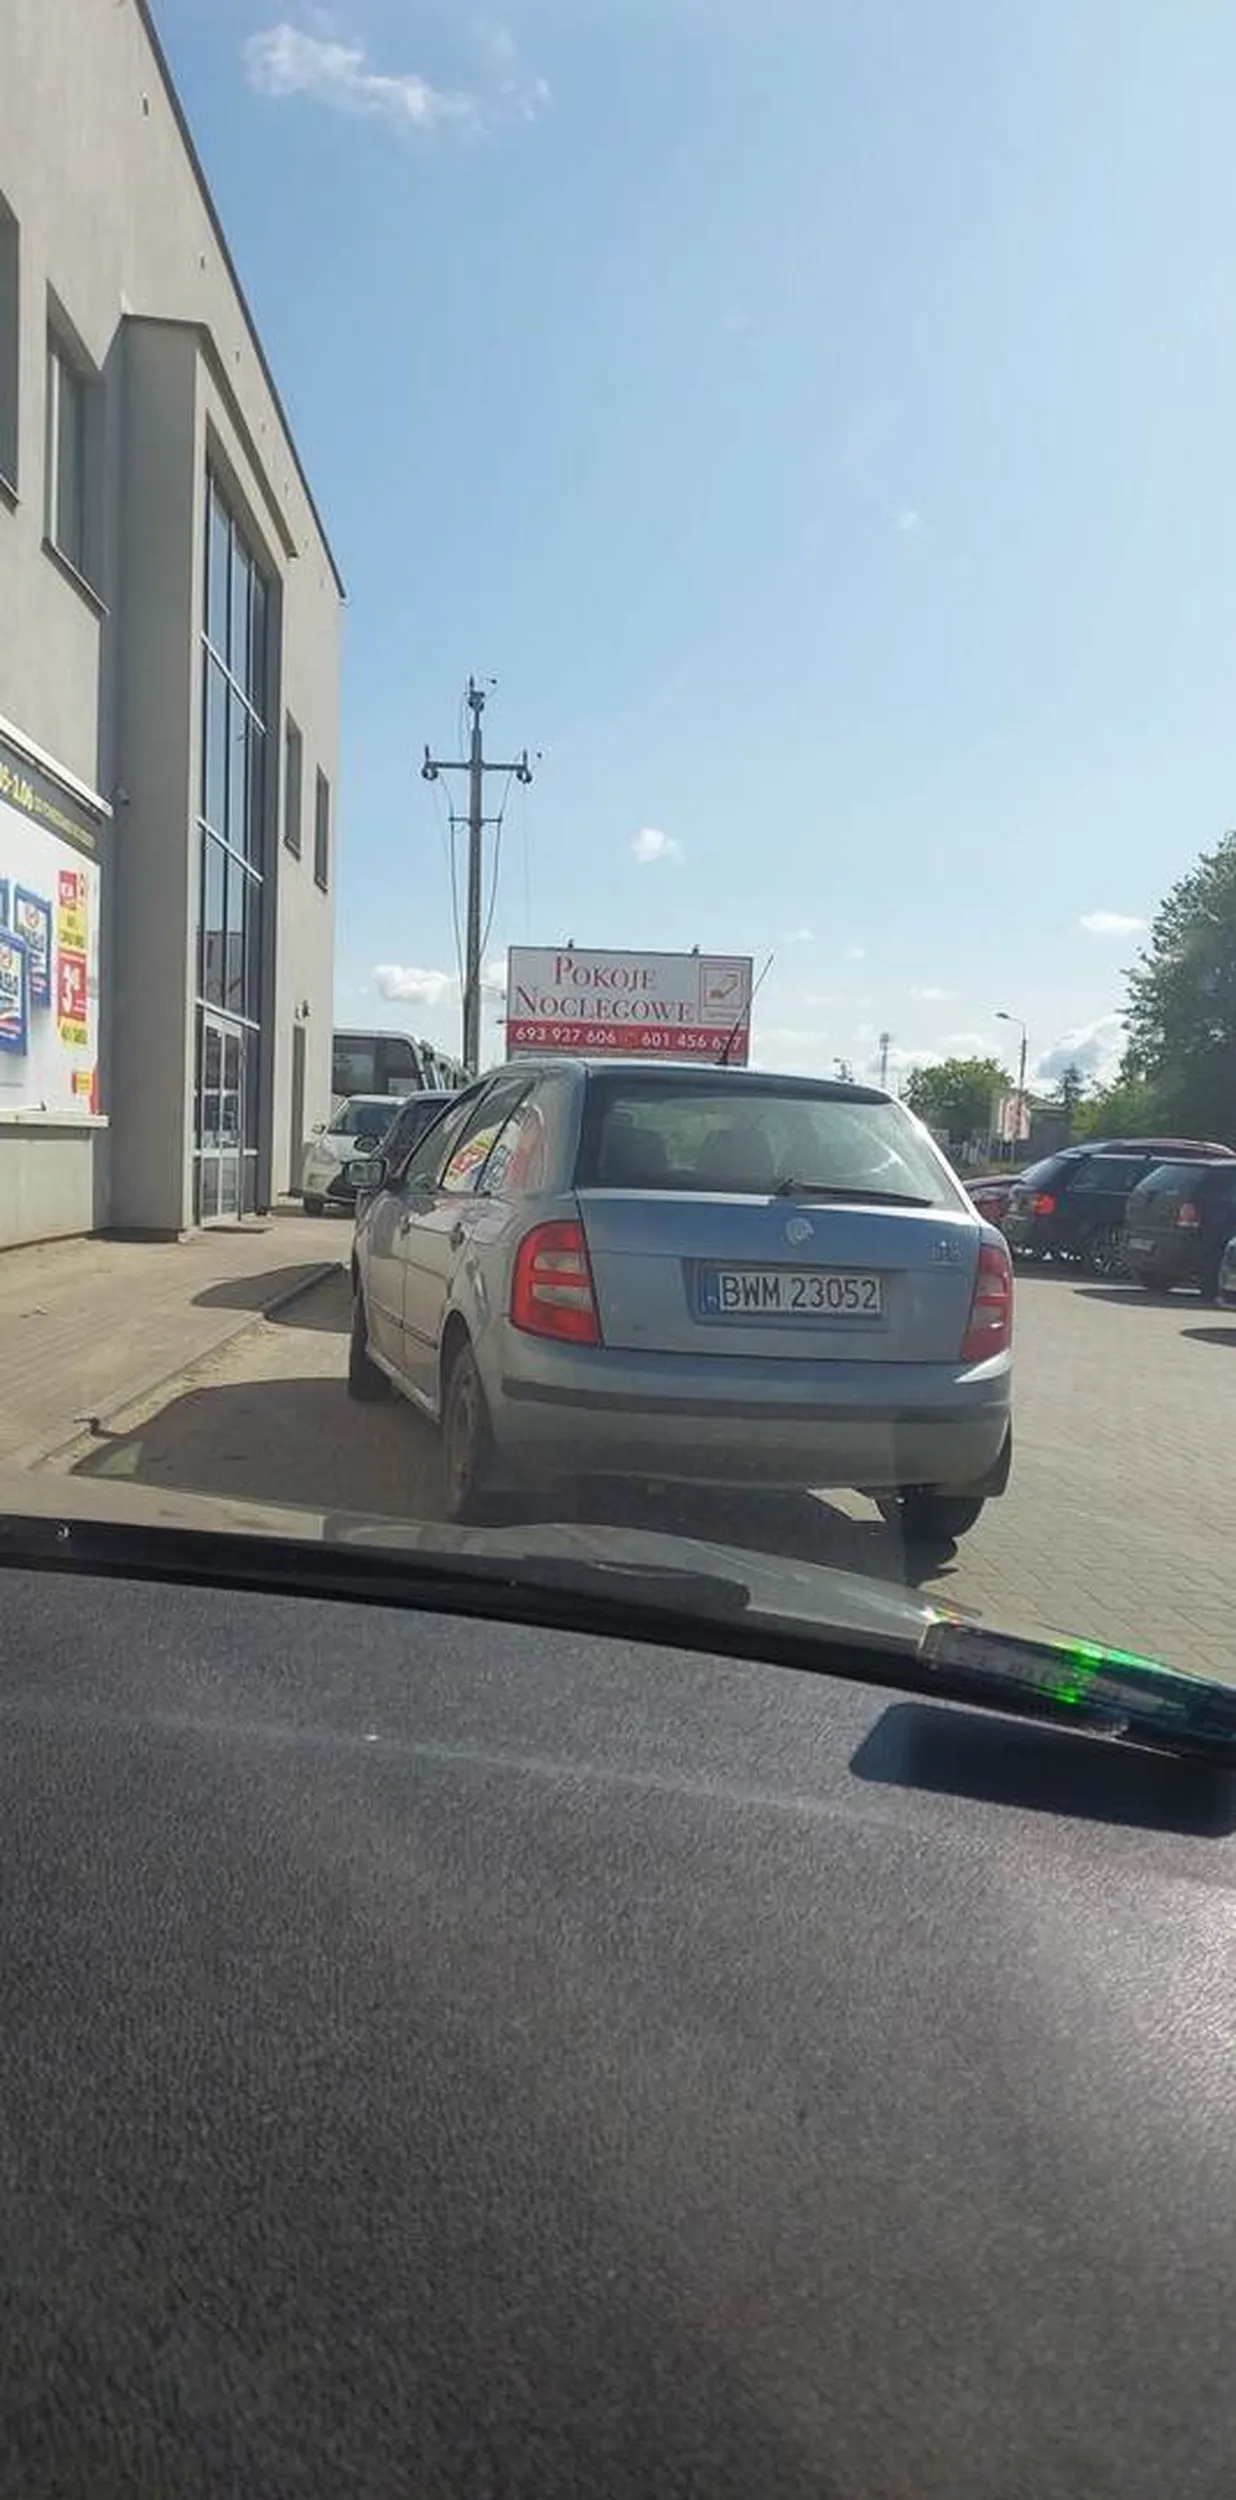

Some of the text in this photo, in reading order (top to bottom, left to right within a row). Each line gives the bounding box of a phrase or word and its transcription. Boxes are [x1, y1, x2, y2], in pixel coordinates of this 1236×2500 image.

[555, 955, 657, 993] POKOJE
[516, 986, 695, 1022] NOCLEGOWE
[515, 1026, 546, 1041] 693
[586, 1030, 616, 1045] 606
[641, 1032, 670, 1047] 601
[677, 1034, 706, 1049] 456
[722, 1276, 878, 1310] BWM 23052
